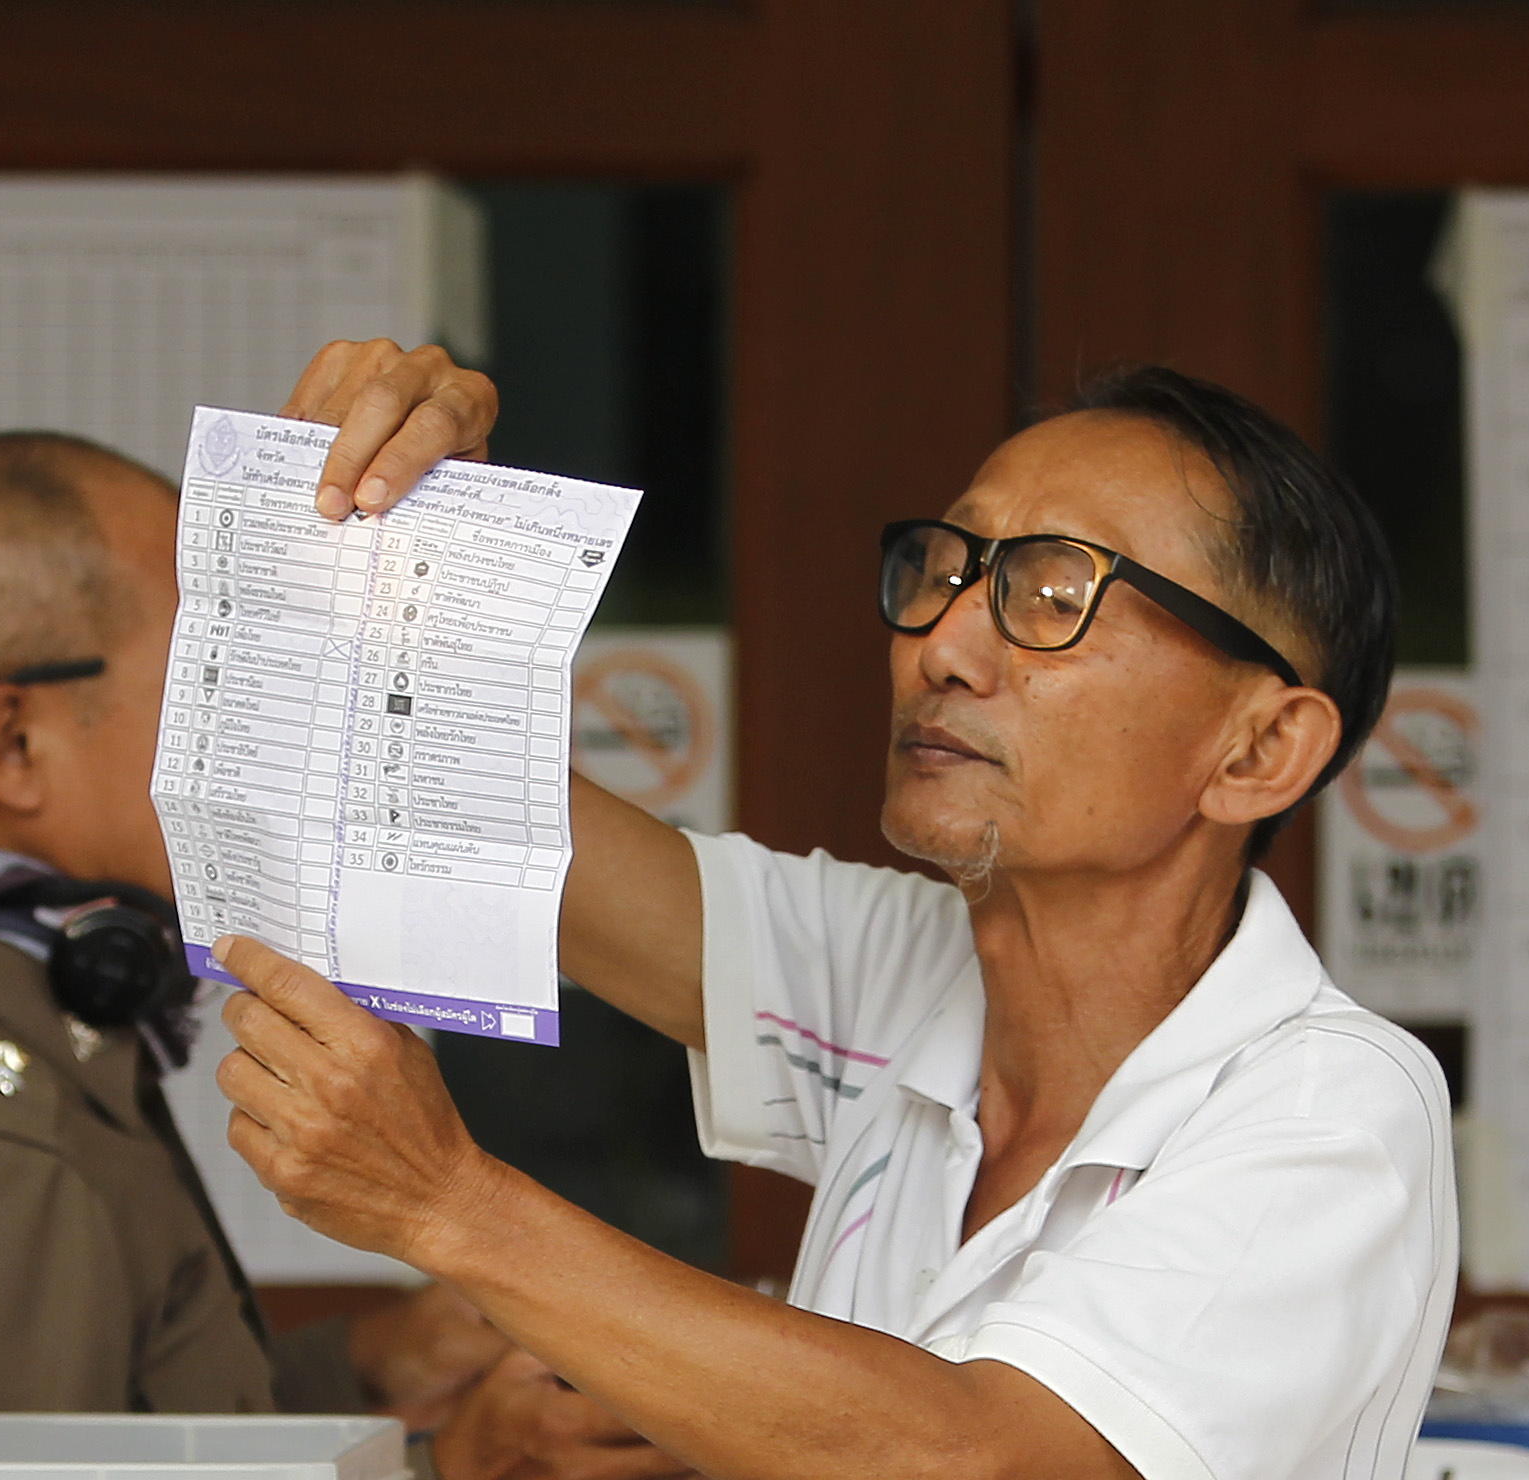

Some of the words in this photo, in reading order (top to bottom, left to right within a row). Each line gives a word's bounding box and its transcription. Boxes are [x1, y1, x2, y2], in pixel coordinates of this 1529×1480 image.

[195, 511, 200, 521] 1
[192, 533, 199, 544] 2
[387, 537, 401, 549] 21
[191, 555, 197, 566] 3
[384, 560, 396, 572] 22
[379, 582, 392, 594] 23
[376, 605, 388, 616] 24
[369, 627, 382, 639] 25
[184, 644, 191, 655] 7
[367, 649, 379, 662] 26
[181, 667, 187, 678] 8
[364, 672, 377, 684] 27
[178, 689, 184, 700] 9
[362, 695, 374, 708] 28
[174, 711, 184, 723] 10
[359, 718, 373, 730] 29
[170, 734, 181, 747] 11
[357, 741, 371, 753] 30
[167, 757, 178, 769] 12
[355, 764, 367, 776] 31
[163, 779, 174, 792] 13
[353, 787, 367, 799] 32
[352, 809, 367, 821] 33
[351, 830, 366, 842] 34
[176, 841, 188, 853] 16
[349, 853, 364, 865] 35
[180, 862, 192, 873] 17
